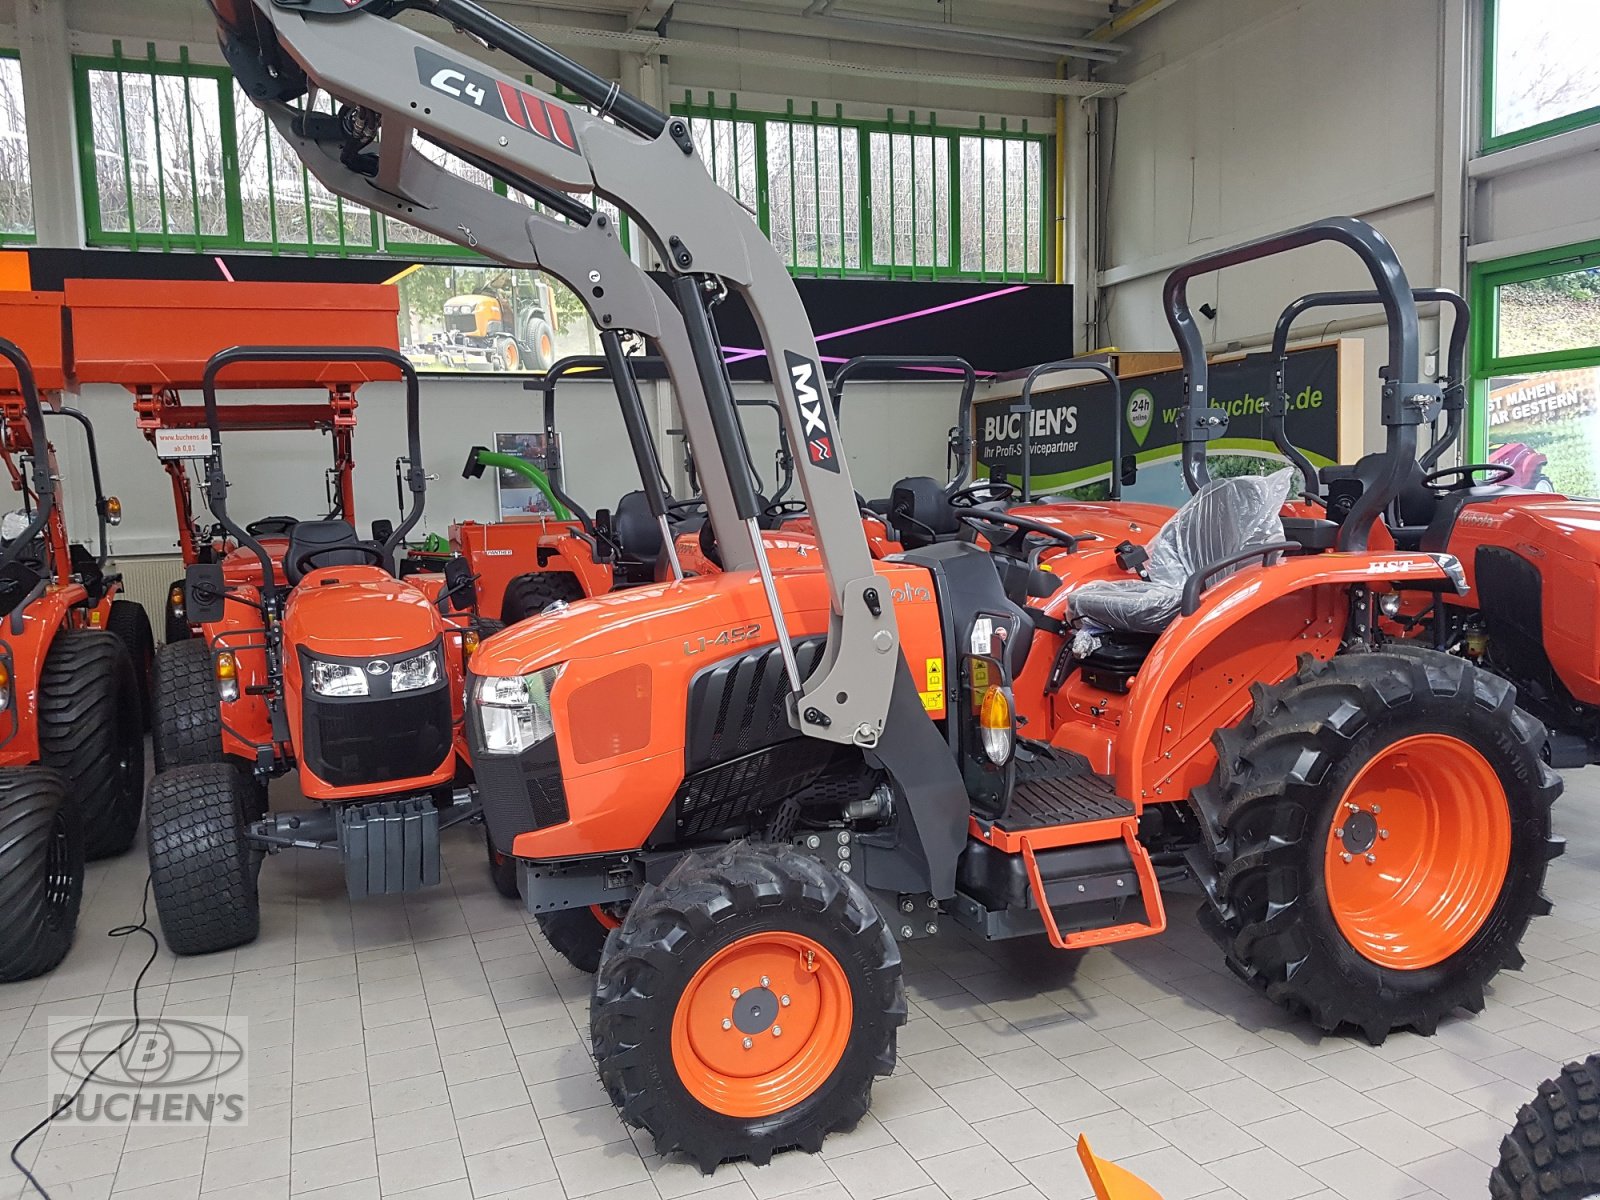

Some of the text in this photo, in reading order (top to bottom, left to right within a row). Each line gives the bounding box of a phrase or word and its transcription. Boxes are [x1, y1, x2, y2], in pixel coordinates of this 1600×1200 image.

[430, 68, 486, 106] C4
[791, 363, 827, 437] MX
[1131, 399, 1150, 413] 24h
[1489, 390, 1578, 425] AR GESTERN
[159, 433, 209, 441] www.buchens.de
[984, 441, 1079, 458] Ihr Profi-Svicepartner
[1367, 560, 1414, 574] HST
[683, 624, 761, 656] L1-452
